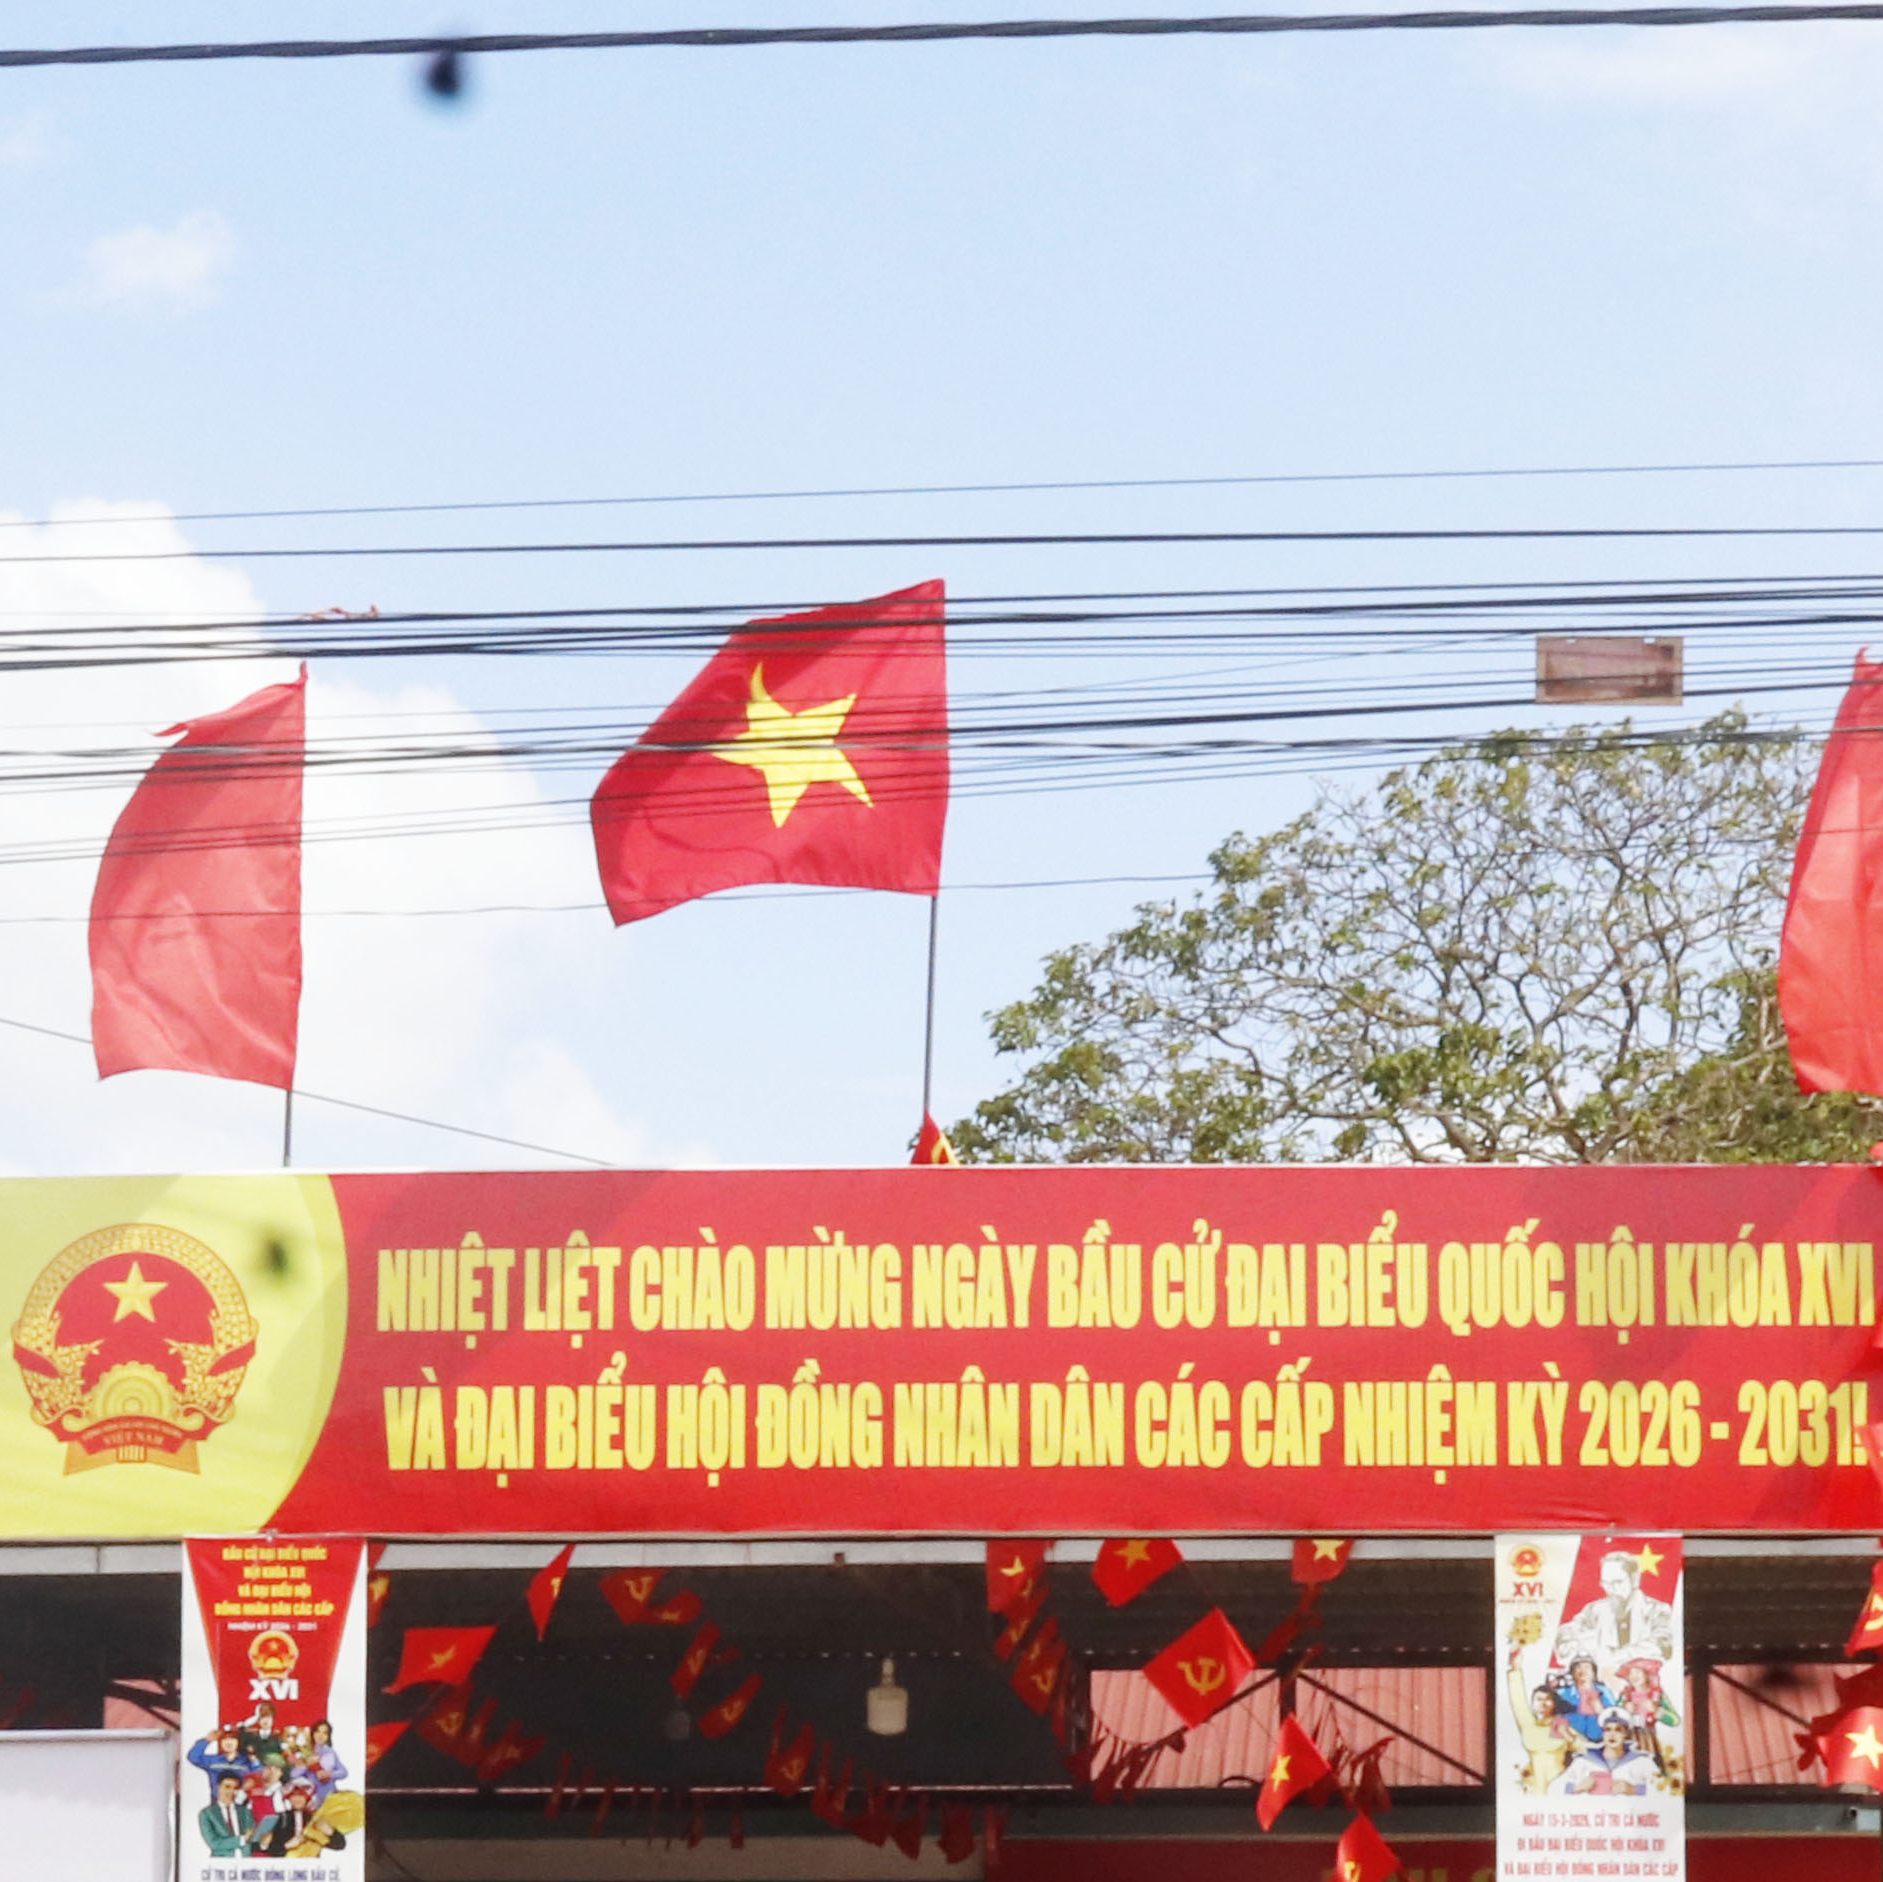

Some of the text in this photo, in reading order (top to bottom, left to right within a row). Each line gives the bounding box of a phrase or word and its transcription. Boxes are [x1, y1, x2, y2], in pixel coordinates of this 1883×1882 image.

[377, 1209, 1875, 1350] NHIỆT LIỆT CHÀO MỪNG NGÀY BẦU CỬ ĐẠI BIỂU QUỐC HỘI KHÓA XVI
[383, 1350, 1868, 1489] VÀ ĐẠI BIỂU HỘI ĐỒNG NHÂN DÂN CÁC CẤP NHIỆM KỲ 2026 - 2031!
[1512, 1581, 1544, 1598] XVI
[249, 1679, 299, 1701] XVI
